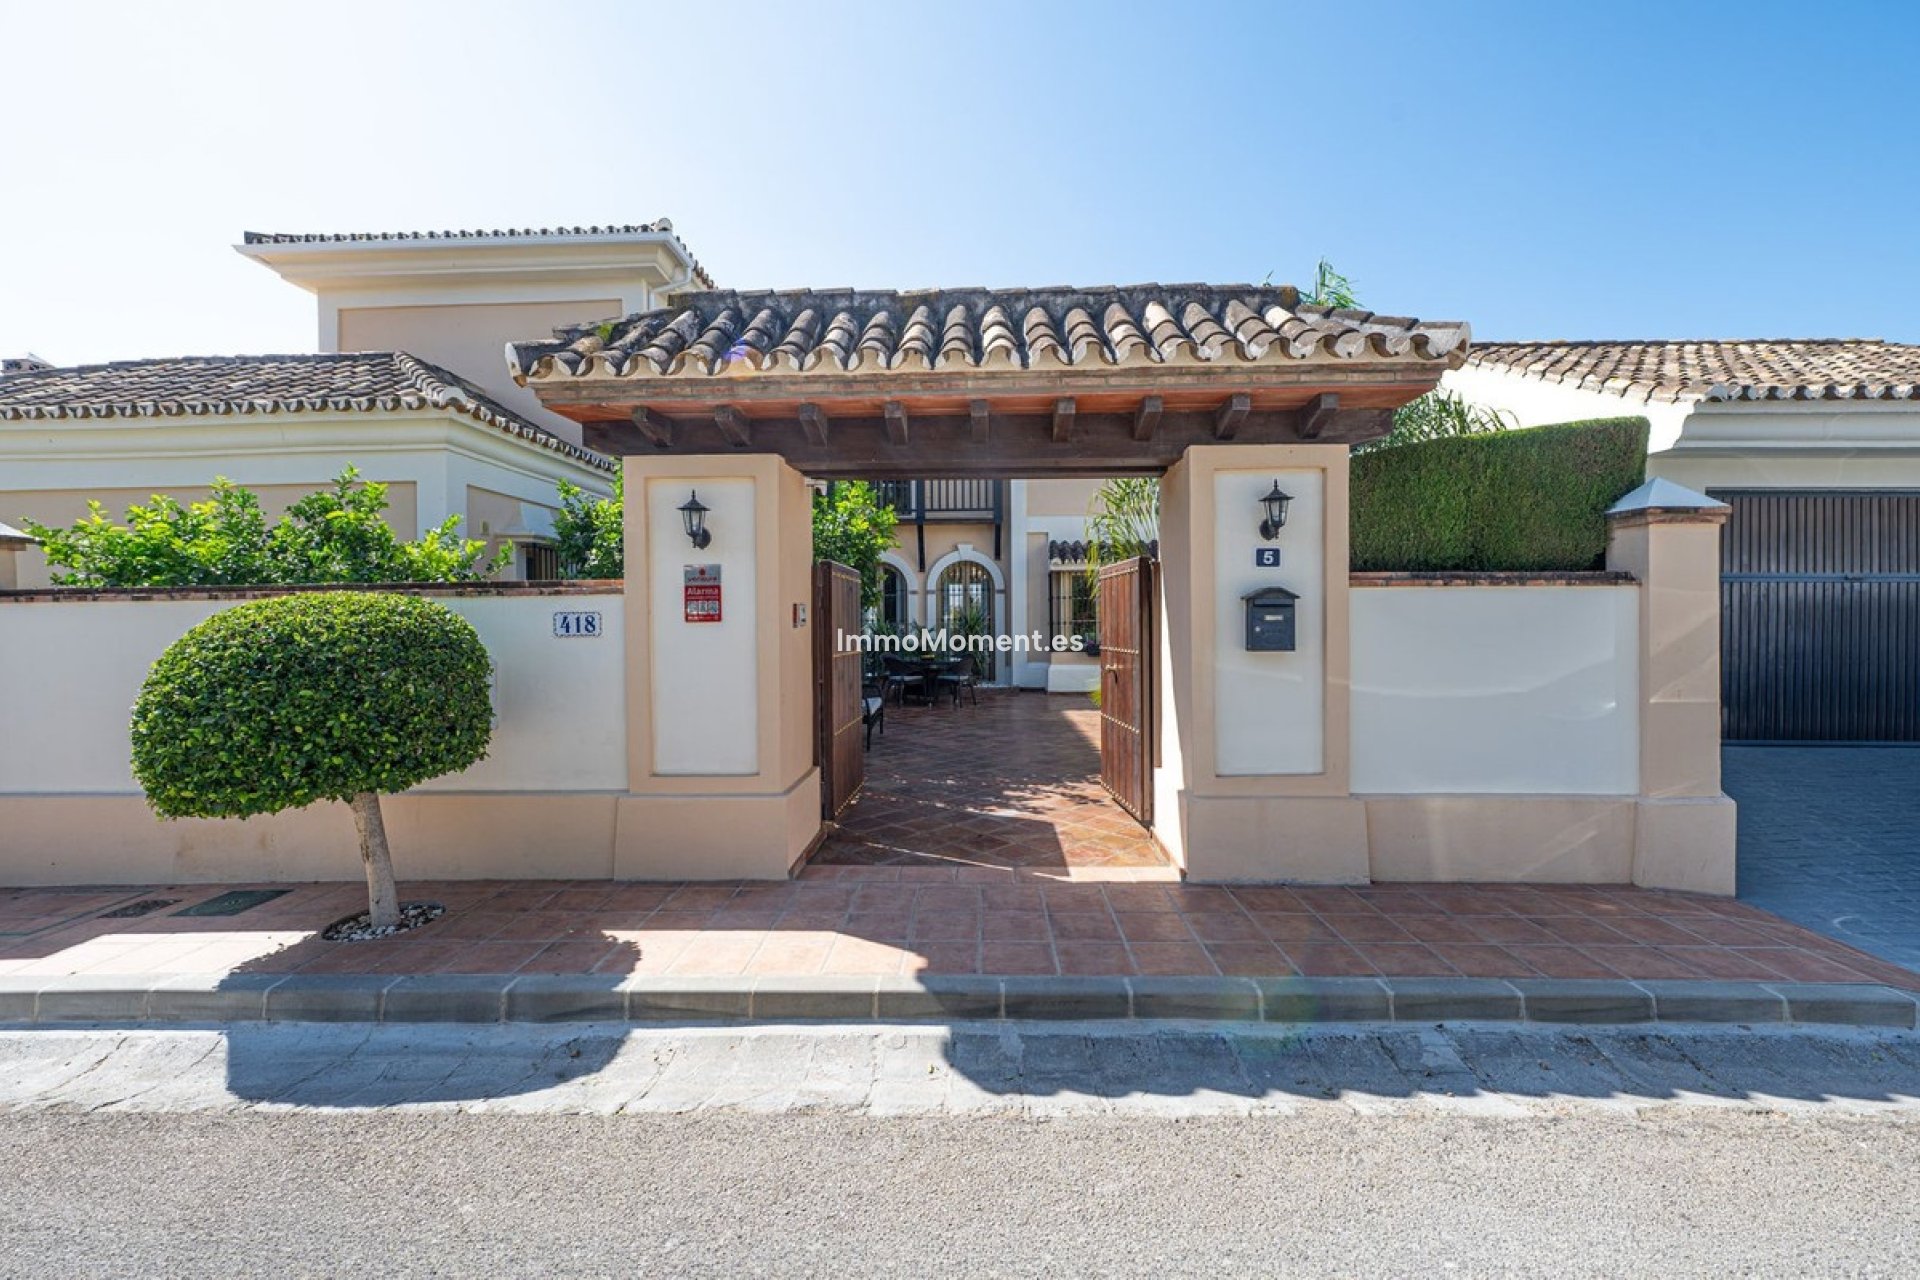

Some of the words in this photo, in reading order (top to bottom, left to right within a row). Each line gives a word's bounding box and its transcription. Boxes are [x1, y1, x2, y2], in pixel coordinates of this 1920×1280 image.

[1263, 550, 1274, 565] 5
[687, 587, 719, 595] Alarma
[560, 615, 596, 633] 418
